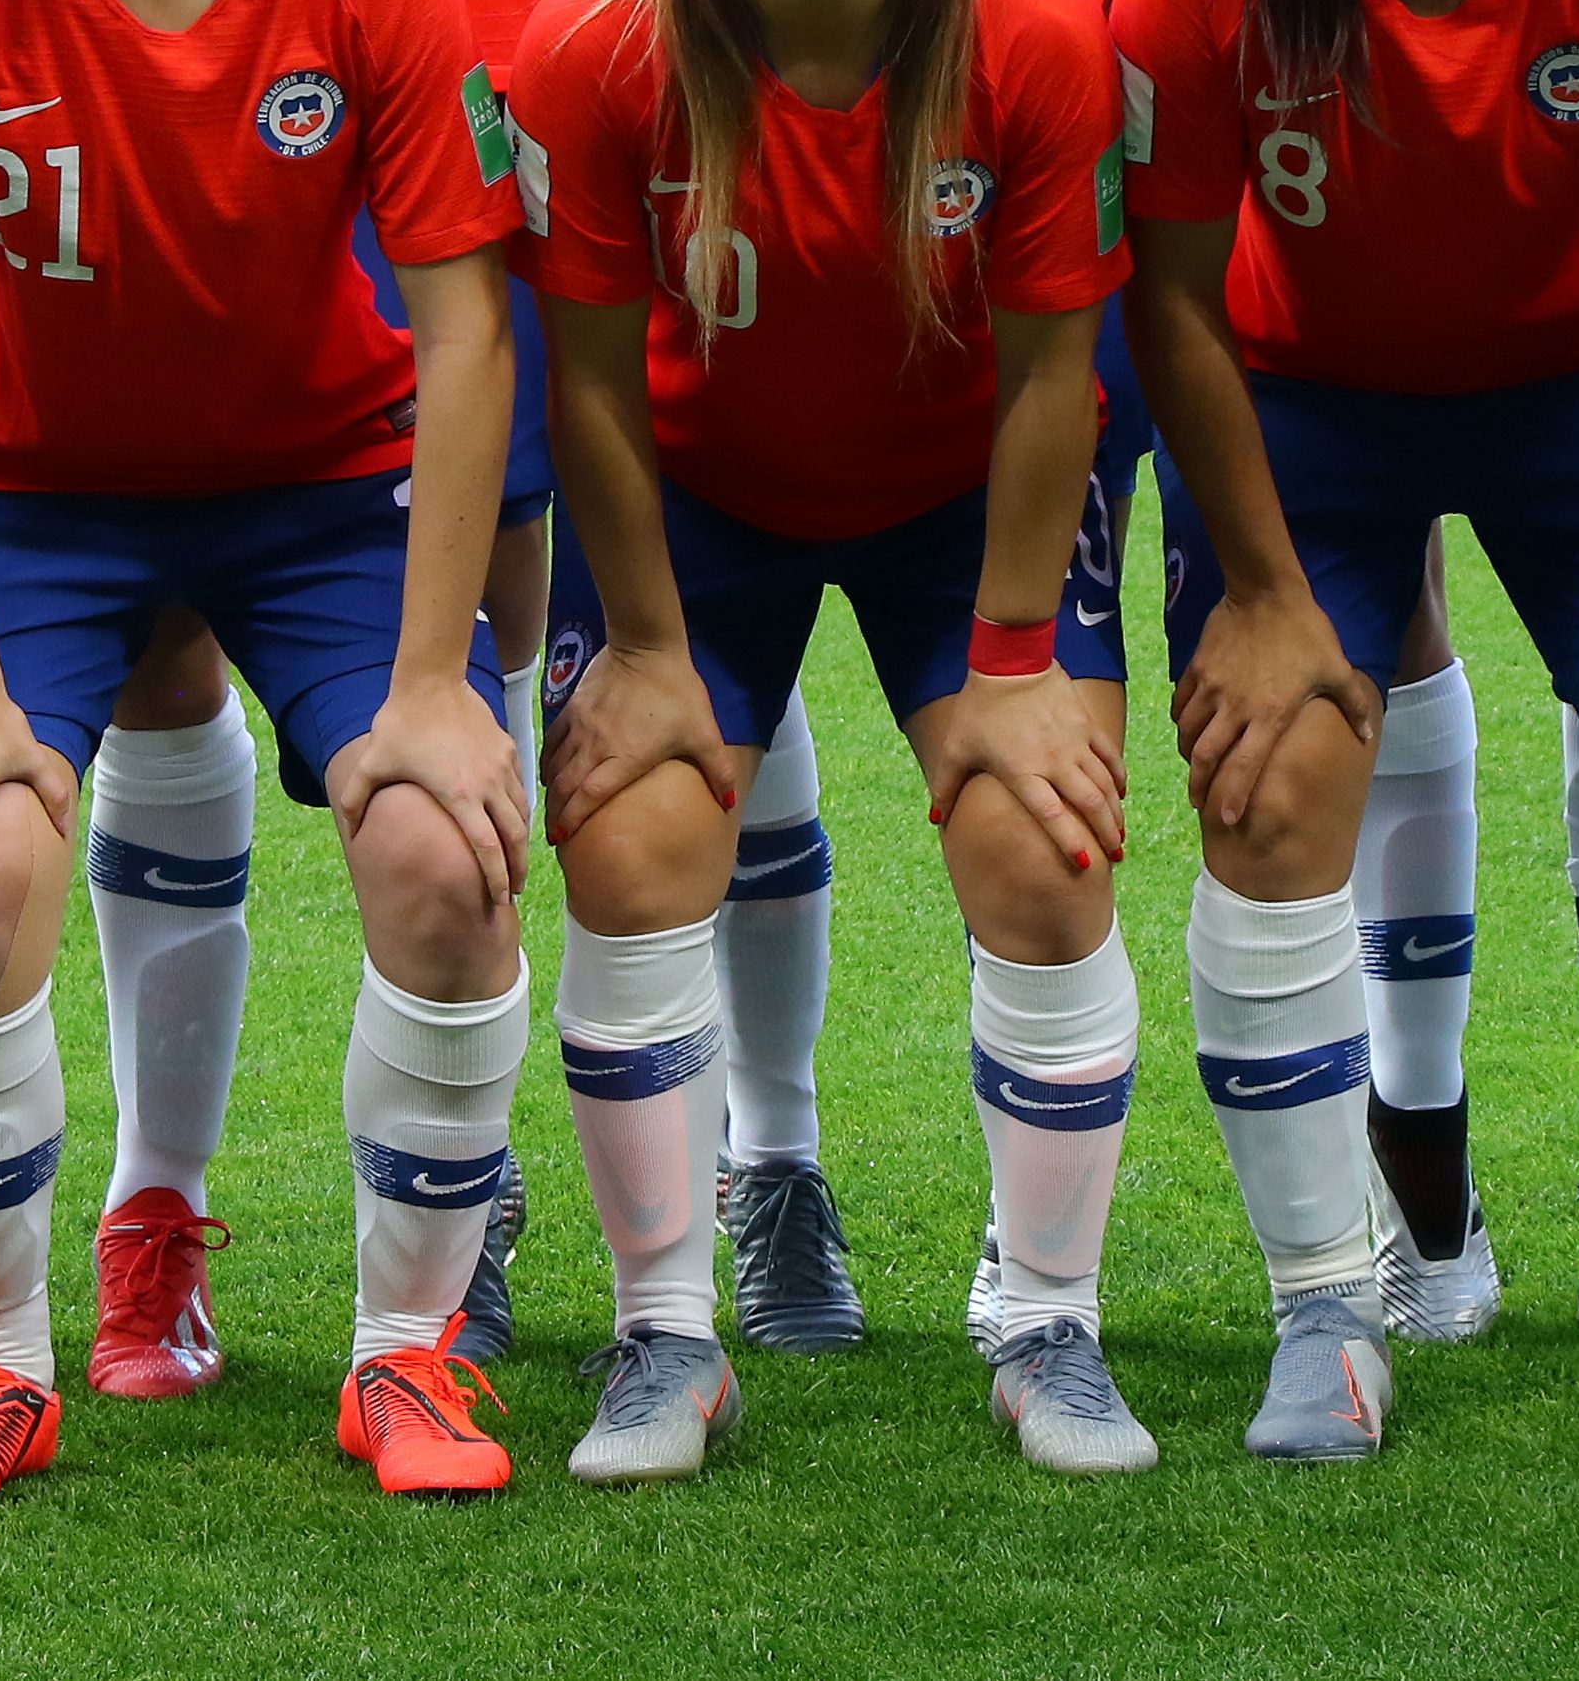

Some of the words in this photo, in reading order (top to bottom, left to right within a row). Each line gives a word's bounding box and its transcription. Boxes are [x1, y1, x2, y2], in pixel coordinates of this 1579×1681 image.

[257, 75, 297, 123] FEDERACION
[305, 74, 318, 83] DE
[321, 77, 344, 107] FUTBOL
[282, 145, 296, 156] DE
[301, 135, 328, 156] CHILE
[1260, 131, 1327, 226] 8
